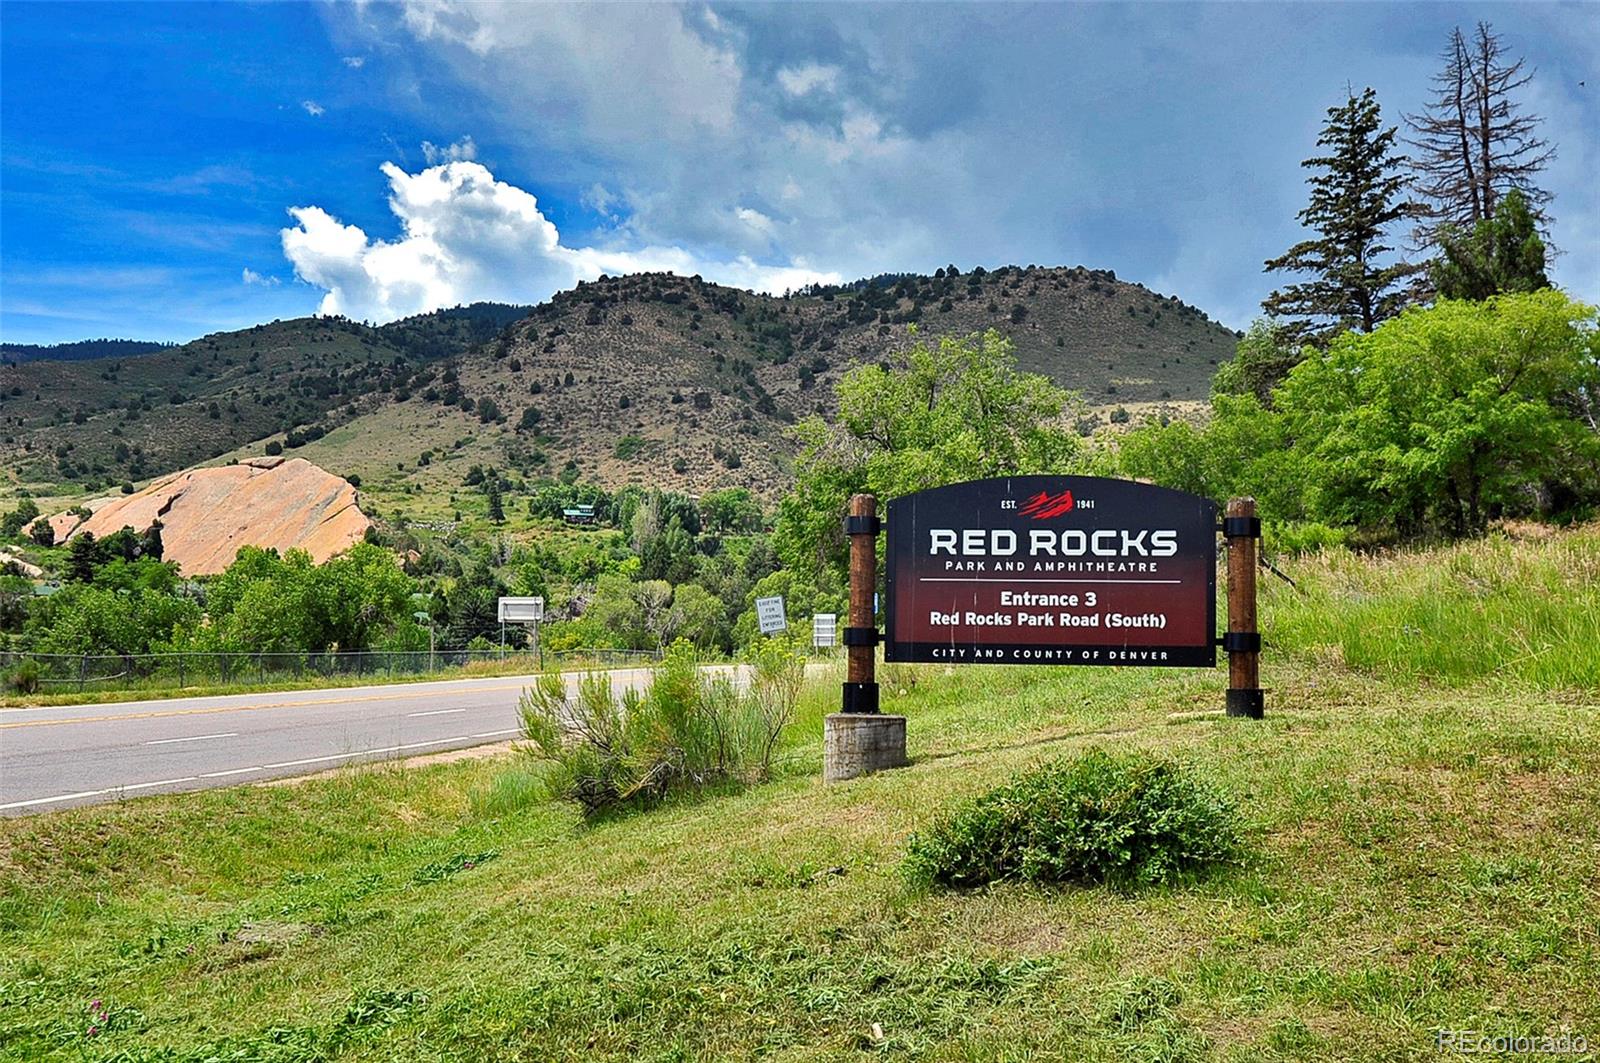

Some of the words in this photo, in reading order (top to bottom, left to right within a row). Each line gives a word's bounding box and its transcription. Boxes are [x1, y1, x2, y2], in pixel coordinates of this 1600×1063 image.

[1001, 500, 1017, 510] EST.
[1077, 500, 1094, 509] 1941
[930, 530, 1016, 556] RED
[1030, 530, 1178, 557] ROCKS
[945, 561, 986, 571] PARK
[995, 562, 1025, 572] AND
[1034, 562, 1157, 573] AMPHITHEATRE
[1001, 591, 1078, 606] Entrance
[1085, 592, 1096, 606] 3
[930, 612, 959, 626] Red
[965, 612, 1012, 626] Rocks
[1017, 613, 1054, 627] Park
[1060, 613, 1099, 627] Road
[1105, 613, 1166, 629] (South)
[932, 648, 965, 657] CITY
[975, 648, 1004, 658] AND
[1013, 649, 1072, 659] COUNTY
[1082, 650, 1099, 659] OF
[1109, 650, 1168, 660] DENVER
